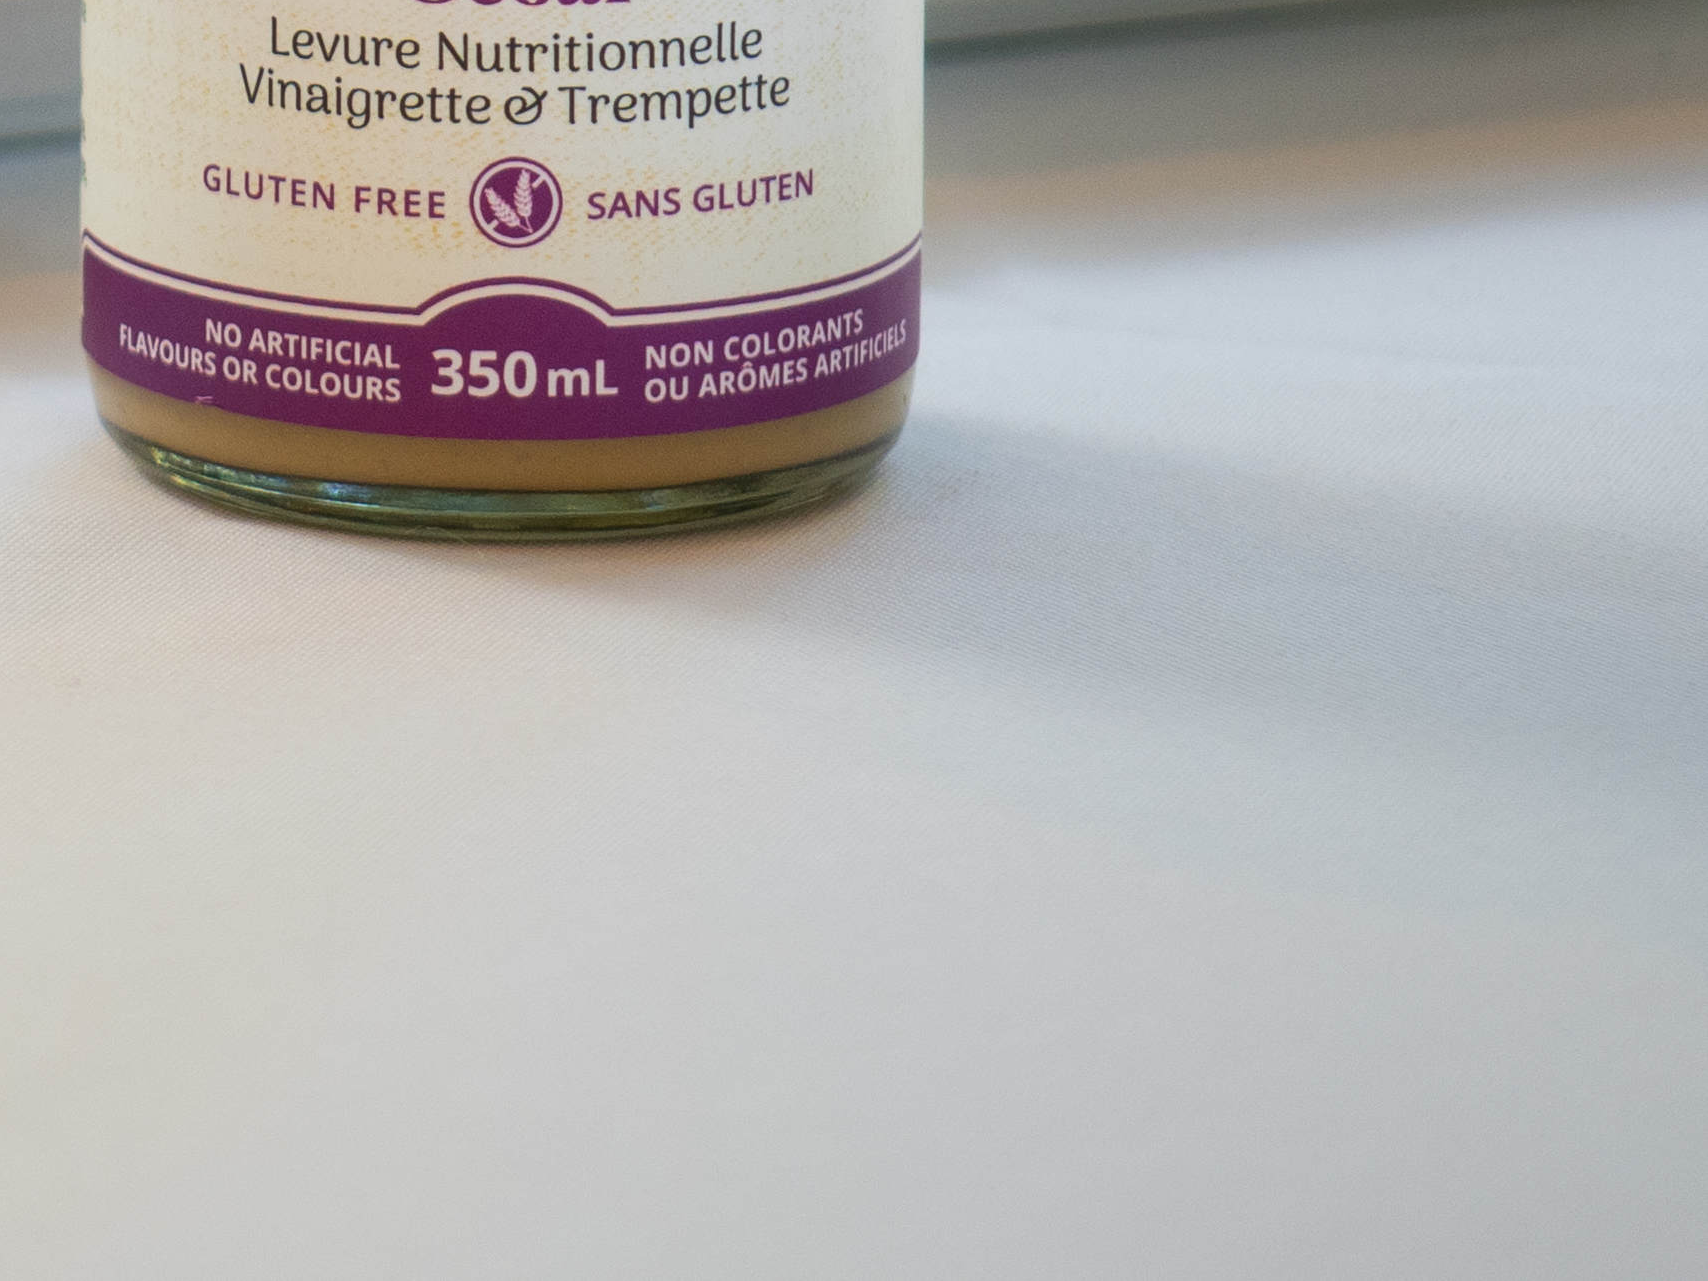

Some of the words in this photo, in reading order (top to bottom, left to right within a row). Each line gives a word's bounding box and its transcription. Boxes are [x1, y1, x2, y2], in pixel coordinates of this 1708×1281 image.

[270, 16, 421, 70] Levure
[436, 22, 764, 74] Nutritionnelle
[239, 64, 491, 129] Vinaigrette
[504, 86, 548, 125] &
[559, 70, 791, 129] Trempette
[202, 163, 336, 211] GLUTEN
[353, 185, 447, 219] FREE
[587, 187, 682, 221] SANS
[692, 167, 815, 214] GLUTEN
[118, 323, 217, 377] FLAVOURS
[222, 354, 259, 385] OR
[265, 362, 402, 403] COLOURS
[204, 318, 242, 347] NO
[248, 326, 401, 369] ARTIFICIAL
[644, 340, 715, 370] NON
[723, 309, 864, 361] COLORANTS
[644, 374, 690, 403] OU
[698, 353, 809, 398] ARÔMES
[814, 320, 908, 377] ARTIFICIELS
[430, 348, 539, 397] 350
[547, 356, 619, 397] mL
